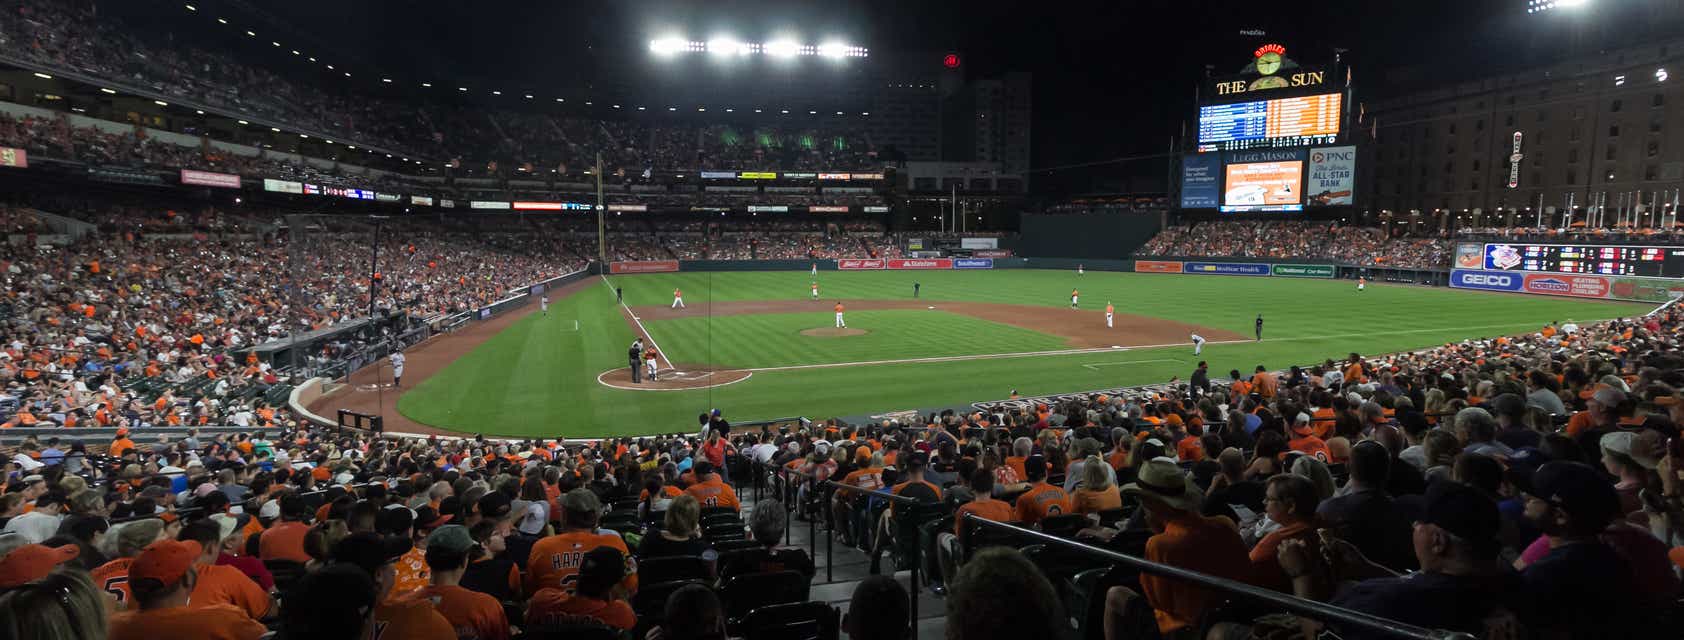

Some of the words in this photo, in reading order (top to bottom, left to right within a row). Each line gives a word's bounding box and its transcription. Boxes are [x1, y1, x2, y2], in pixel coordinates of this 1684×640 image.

[1254, 44, 1285, 57] ORIOLES
[1216, 80, 1246, 94] THE
[1291, 71, 1324, 87] SUN
[1261, 151, 1297, 161] MASON
[1327, 151, 1353, 161] PNC
[1312, 170, 1350, 180] ALL-STAR
[1320, 179, 1341, 188] BANK
[1462, 274, 1511, 286] GEICO
[1530, 282, 1569, 291] HORIZON
[552, 552, 584, 569] HAR
[104, 575, 129, 609] 5
